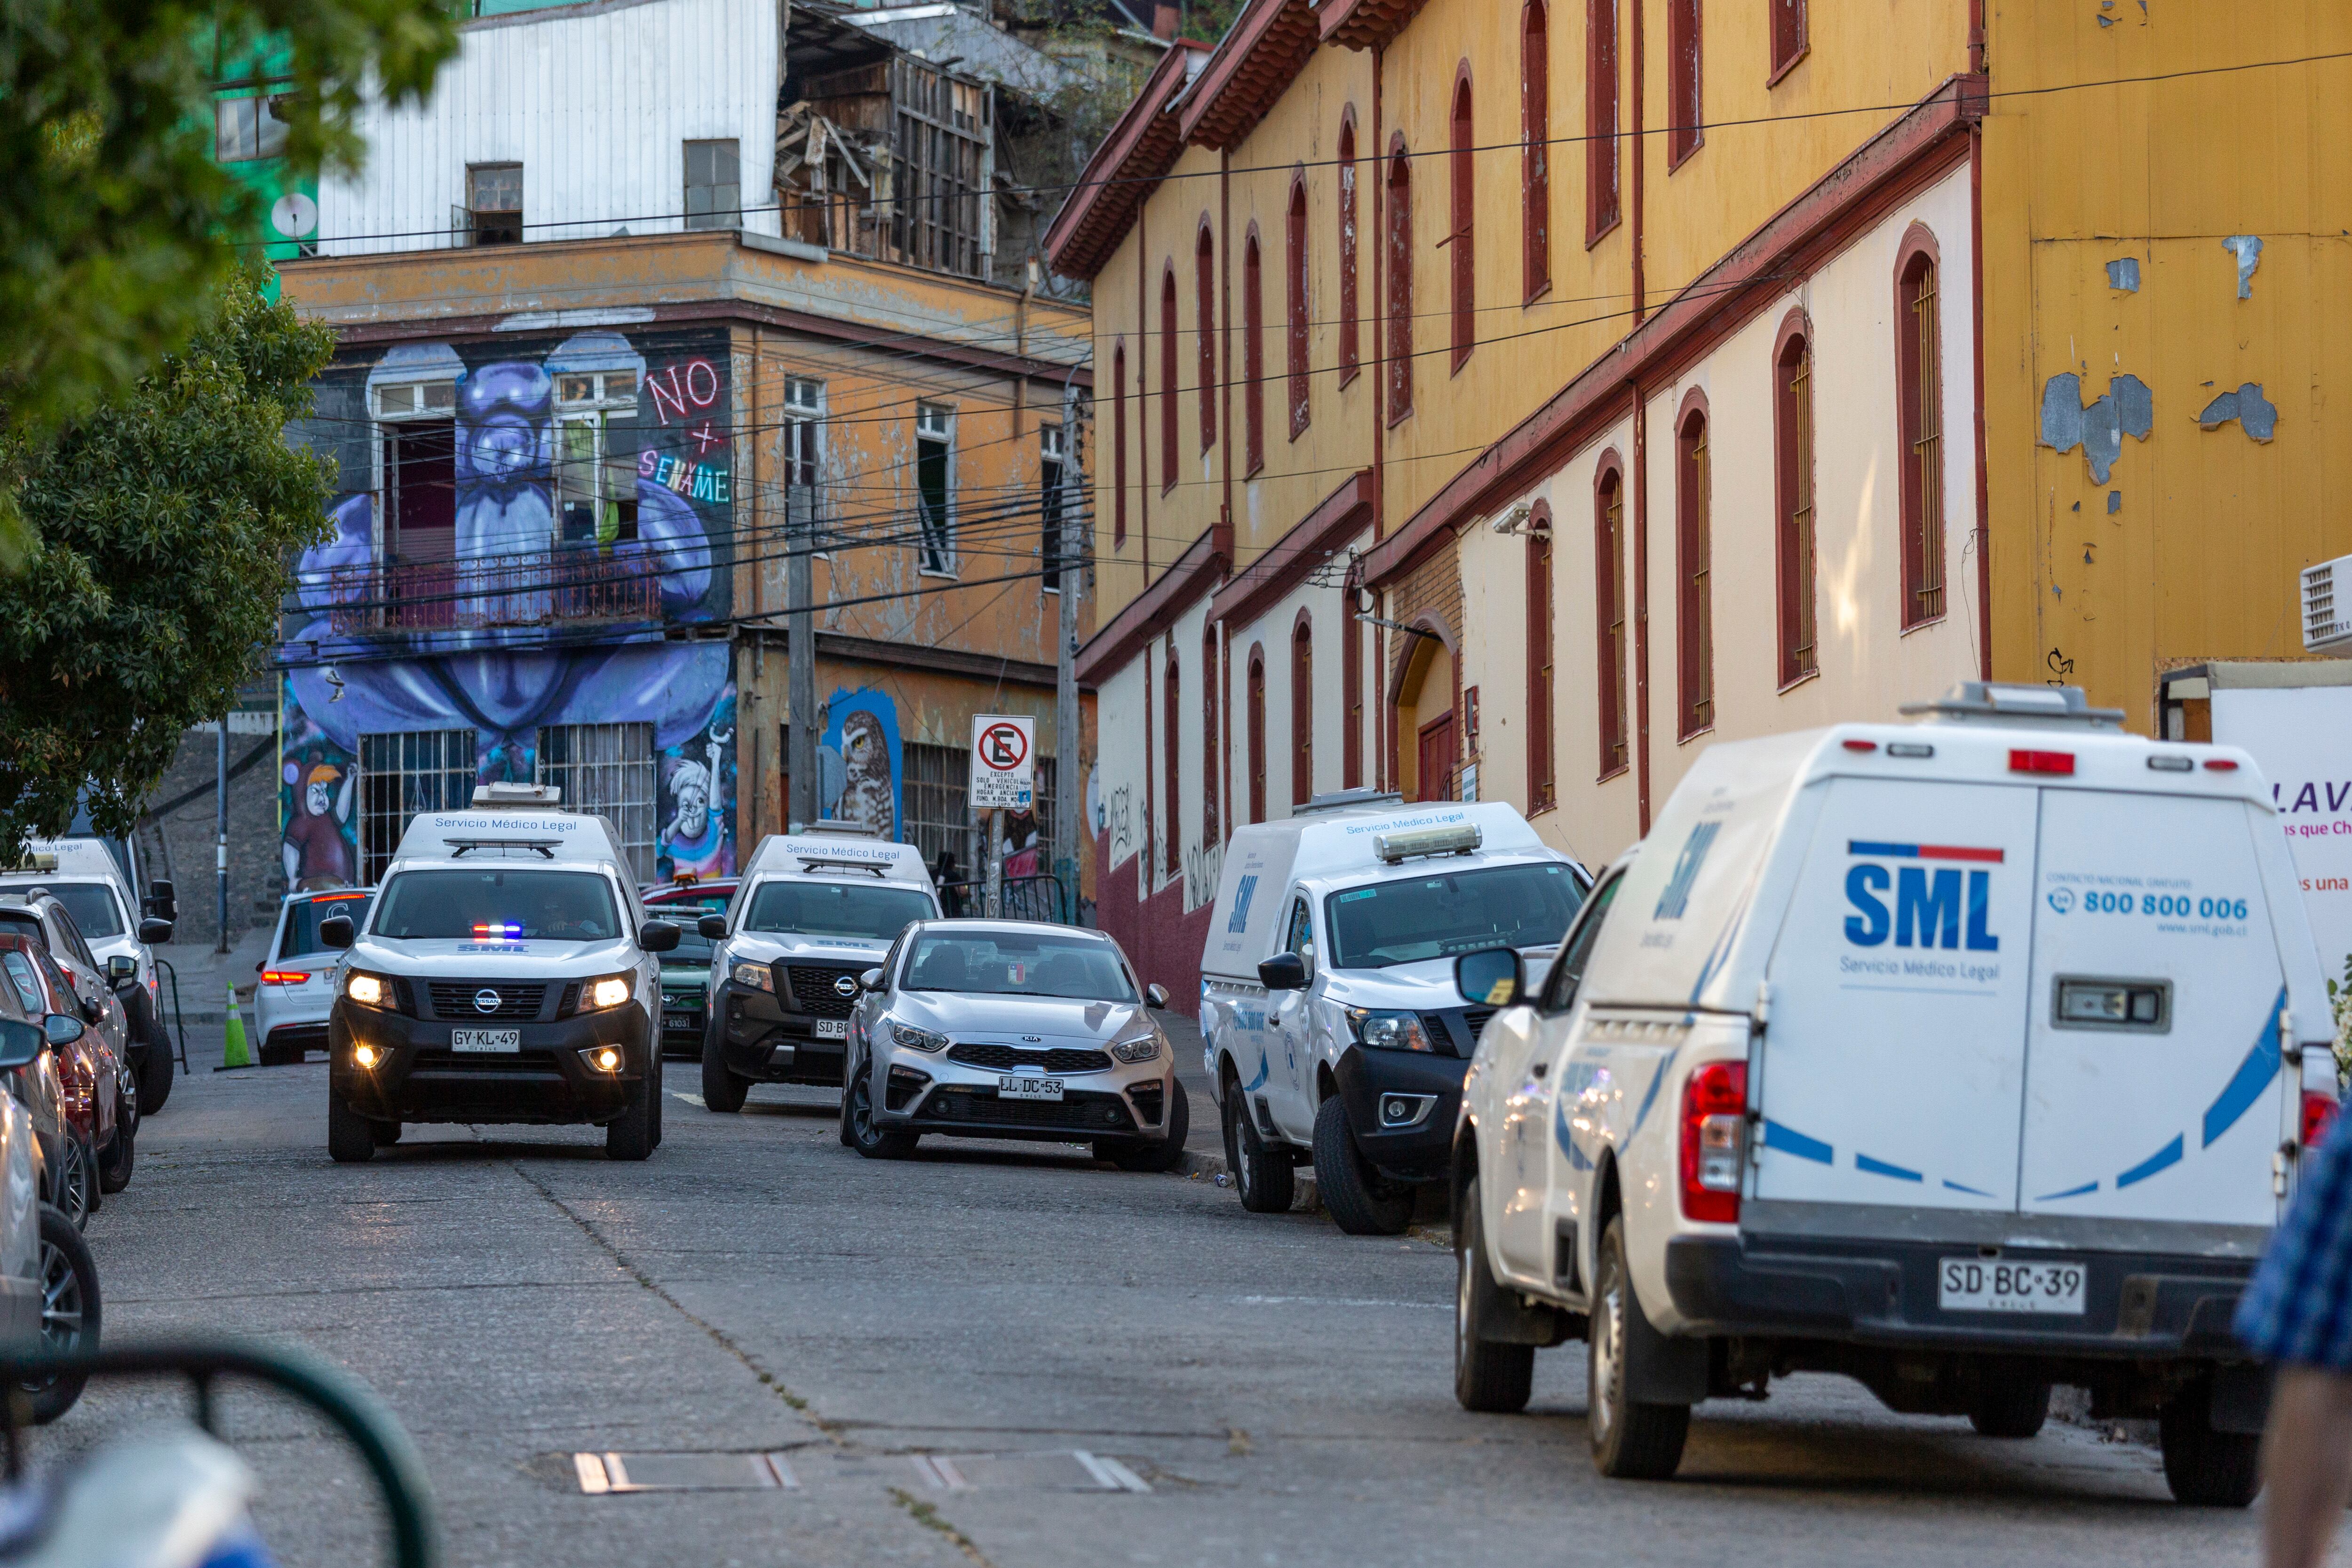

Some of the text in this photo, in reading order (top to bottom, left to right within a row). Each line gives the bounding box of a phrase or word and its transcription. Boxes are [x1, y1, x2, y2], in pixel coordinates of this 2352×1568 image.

[645, 361, 717, 426] NO
[638, 449, 729, 503] SENAME
[993, 730, 1014, 763] E
[435, 818, 576, 832] Servicio Médico Legal
[1346, 812, 1464, 835] Servicio Médico Legal
[2300, 824, 2328, 839] que
[55, 843, 82, 853] Legal
[786, 844, 900, 860] Servicio Médico Legal
[2298, 878, 2348, 891] s una
[1843, 862, 1998, 952] SML
[2084, 891, 2247, 920] 800 800 006
[1840, 955, 1899, 973] Servicio
[1960, 963, 1999, 983] Legal
